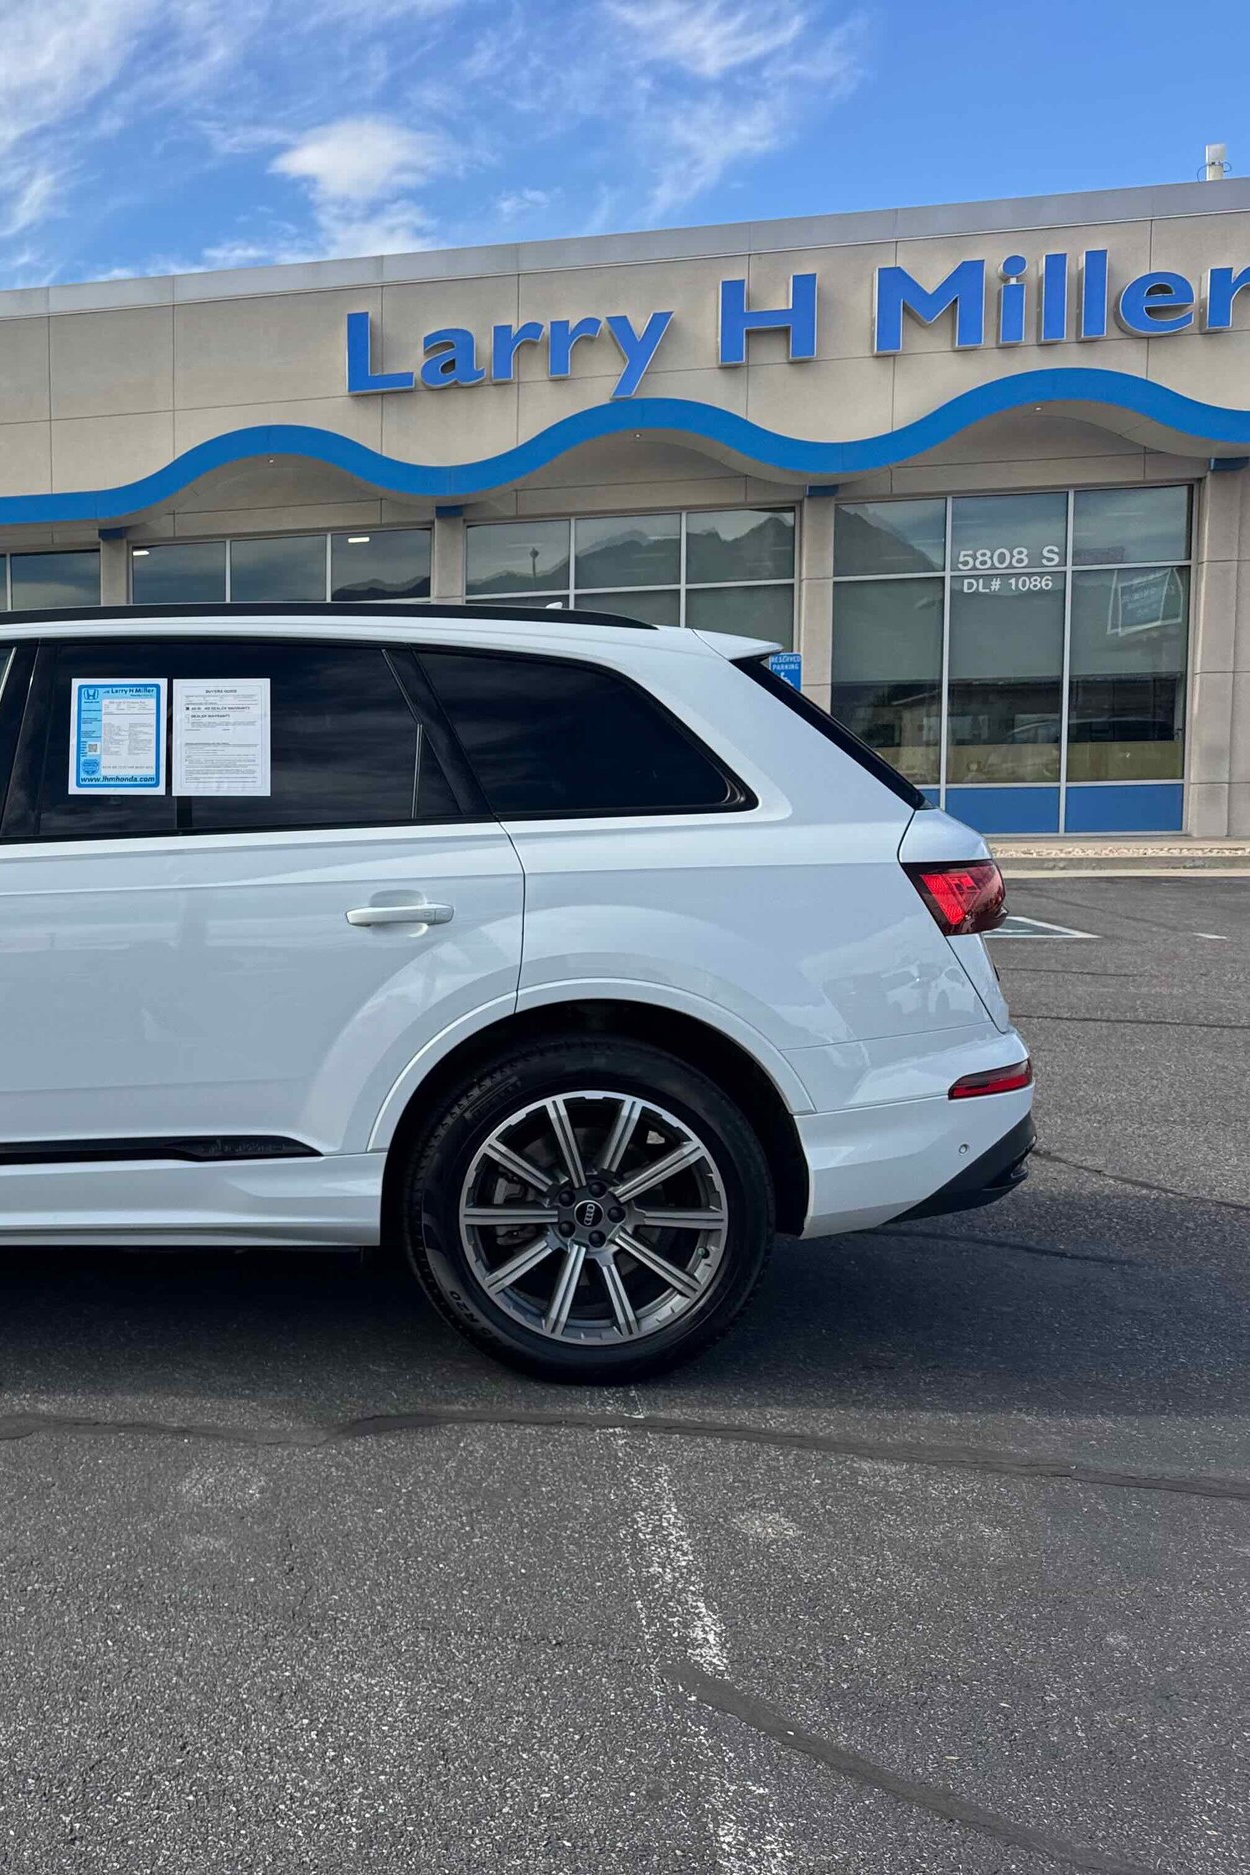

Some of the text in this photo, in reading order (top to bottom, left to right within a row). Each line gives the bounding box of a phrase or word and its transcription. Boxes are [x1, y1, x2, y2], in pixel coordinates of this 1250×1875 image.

[347, 248, 1250, 400] Larry H Miller
[958, 545, 1060, 571] 5808 S
[963, 575, 1053, 593] DL# 1086
[772, 655, 801, 663] RESERVED
[80, 775, 155, 783] www.lhmhonda.com
